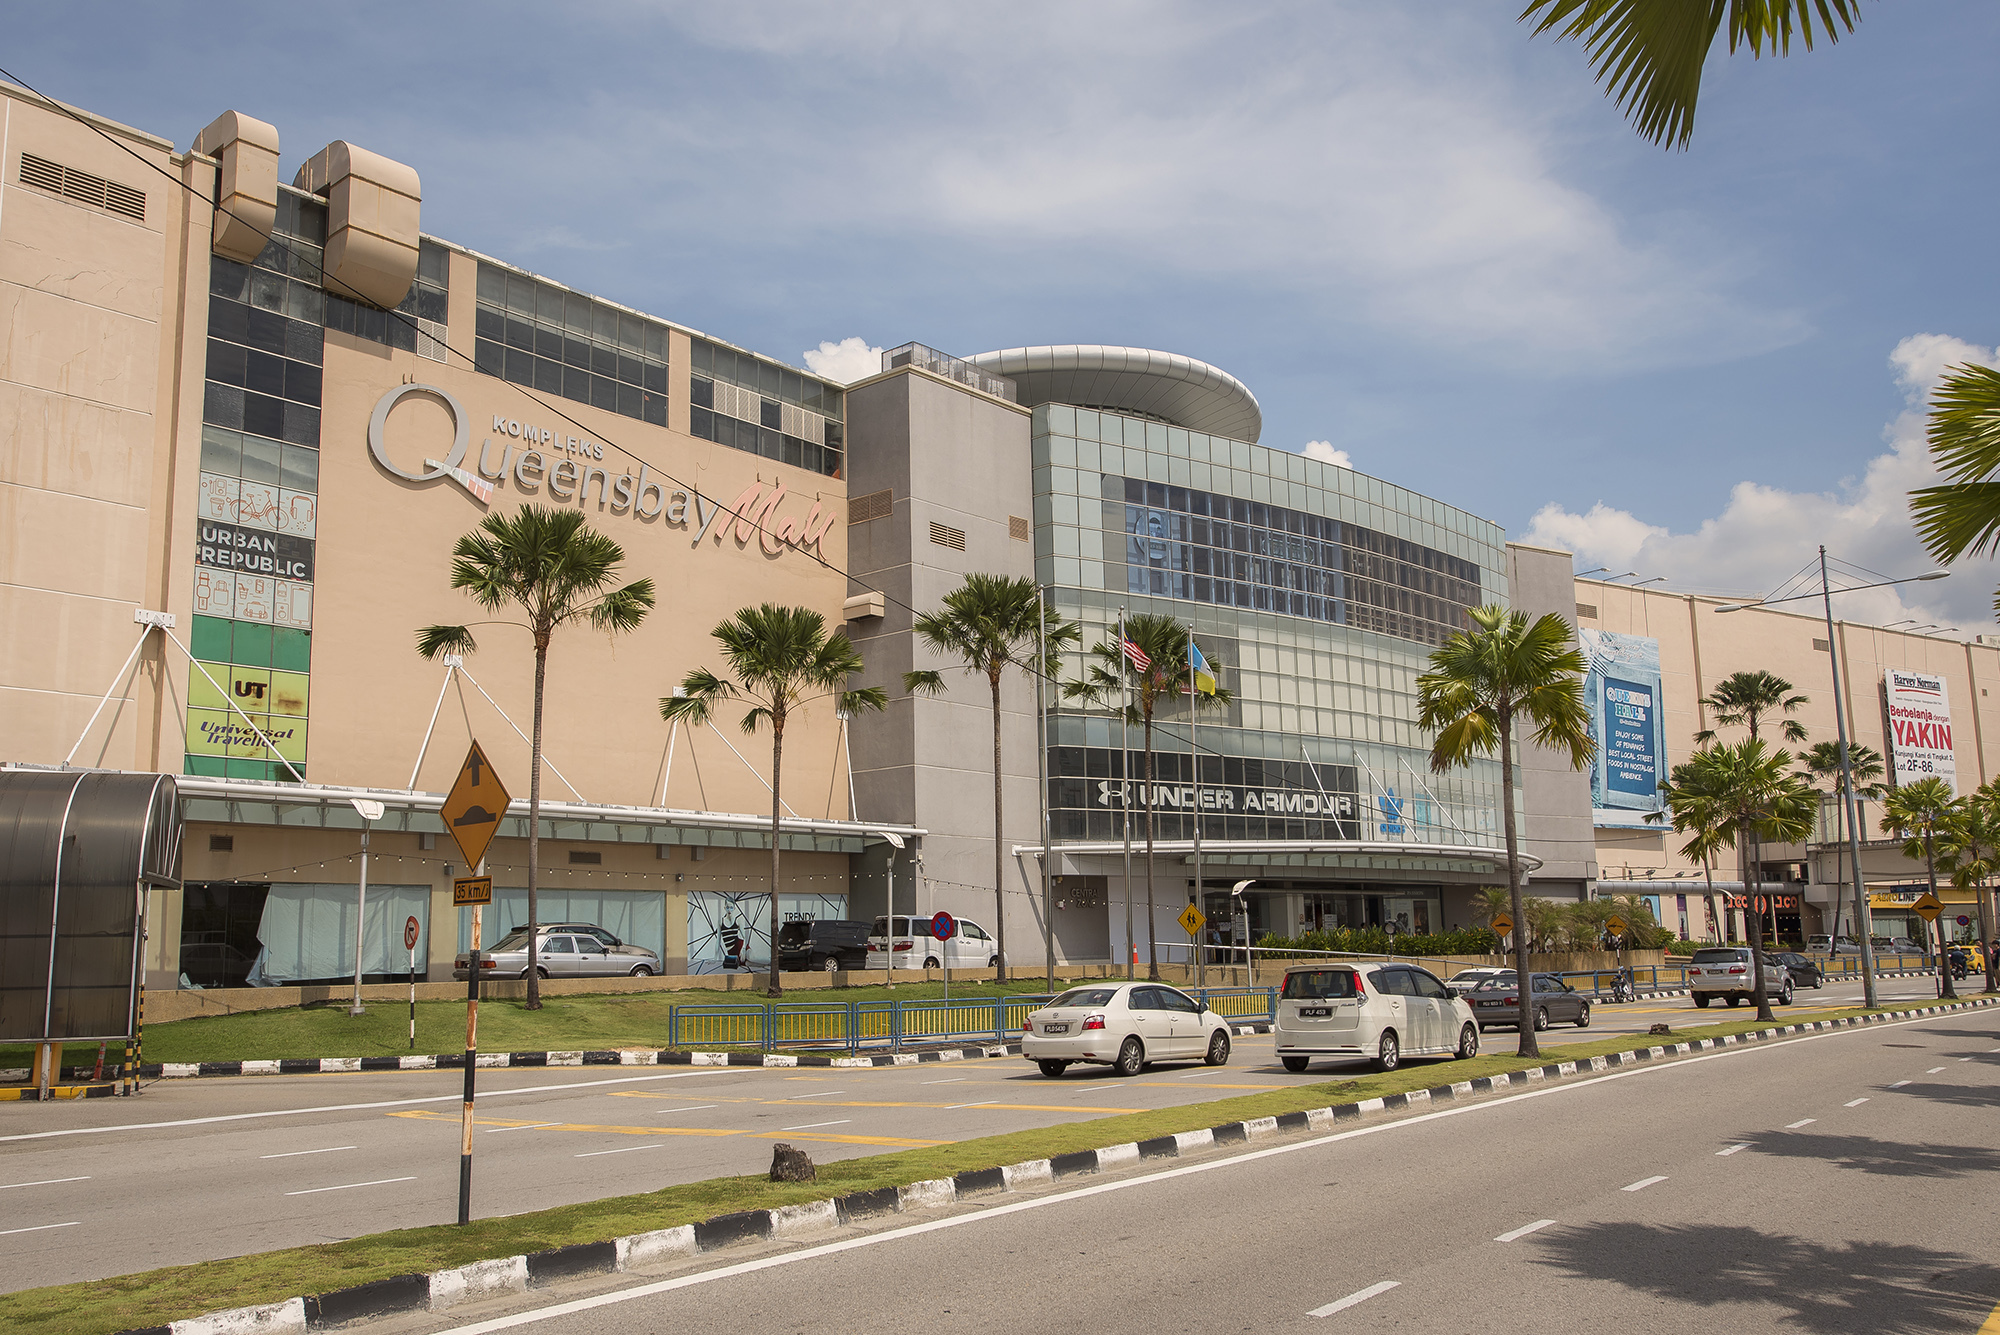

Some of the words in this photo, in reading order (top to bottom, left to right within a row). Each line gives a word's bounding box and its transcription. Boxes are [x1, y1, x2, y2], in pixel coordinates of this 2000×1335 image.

[492, 414, 604, 459] KOMPLEKS
[368, 383, 720, 542] Queensbay
[713, 482, 837, 562] Mall
[202, 526, 276, 553] URBAN
[201, 545, 306, 577] REPUBLIC
[235, 680, 268, 699] UT
[1893, 674, 1916, 688] Harvey
[1916, 677, 1941, 690] Norman
[1606, 687, 1651, 708] QUEENS
[1615, 703, 1646, 721] HALL
[1890, 705, 1932, 722] Berbelanja
[200, 721, 294, 739] Universal
[1615, 730, 1631, 739] ENJOY
[1631, 733, 1645, 741] SOME
[1892, 719, 1953, 750] YAKIN
[1615, 740, 1622, 748] OF
[1608, 748, 1620, 757] BEST
[1621, 751, 1636, 760] LOCAL
[1608, 759, 1623, 768] FOODS
[1896, 762, 1906, 771] Lot
[1906, 759, 1933, 773] 2F-86
[1140, 784, 1234, 810] UNDER
[1242, 791, 1352, 815] ARMOUR
[457, 884, 466, 899] 35
[1875, 892, 1916, 902] AEROLINE
[1775, 896, 1798, 908] J.CO
[784, 912, 816, 921] TRENDY
